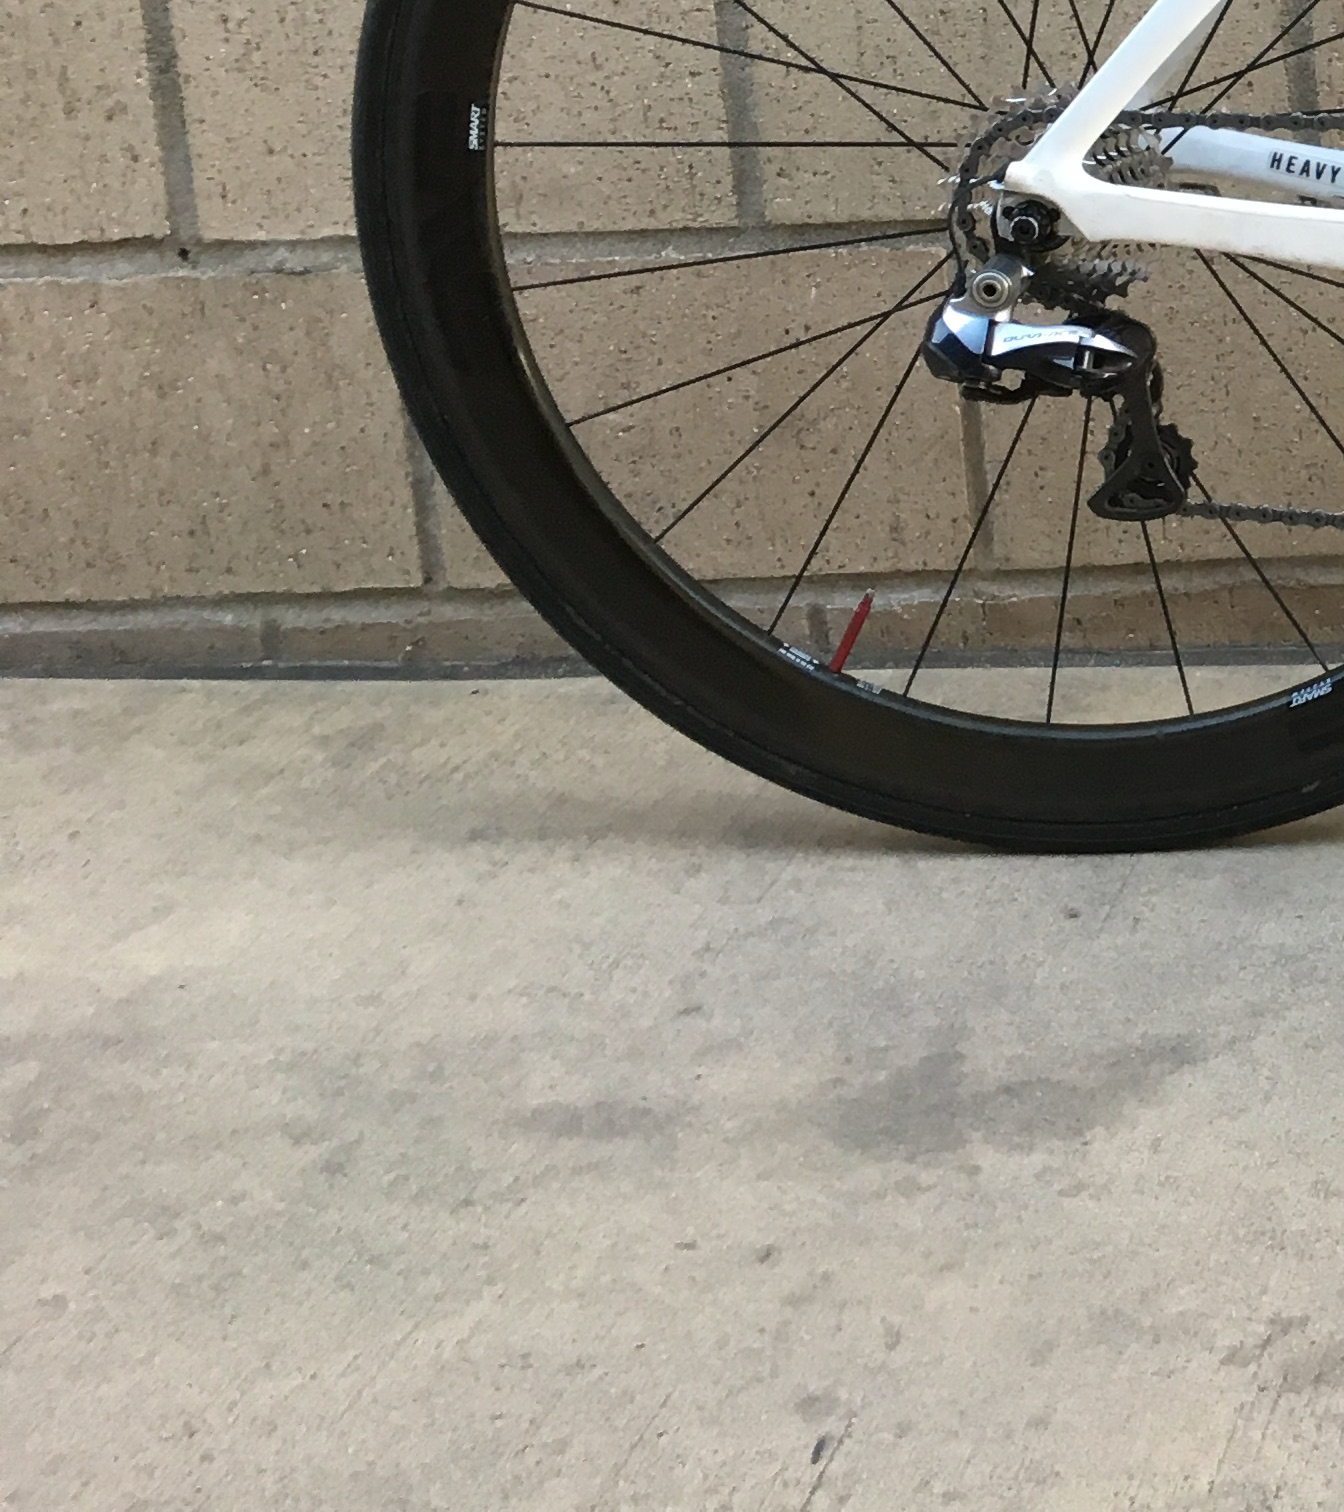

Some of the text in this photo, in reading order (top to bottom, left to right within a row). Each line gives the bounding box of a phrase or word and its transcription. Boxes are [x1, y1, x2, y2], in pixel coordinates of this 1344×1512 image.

[469, 103, 480, 150] SMART
[1270, 152, 1341, 184] HEAVY
[1289, 683, 1333, 708] SMART
